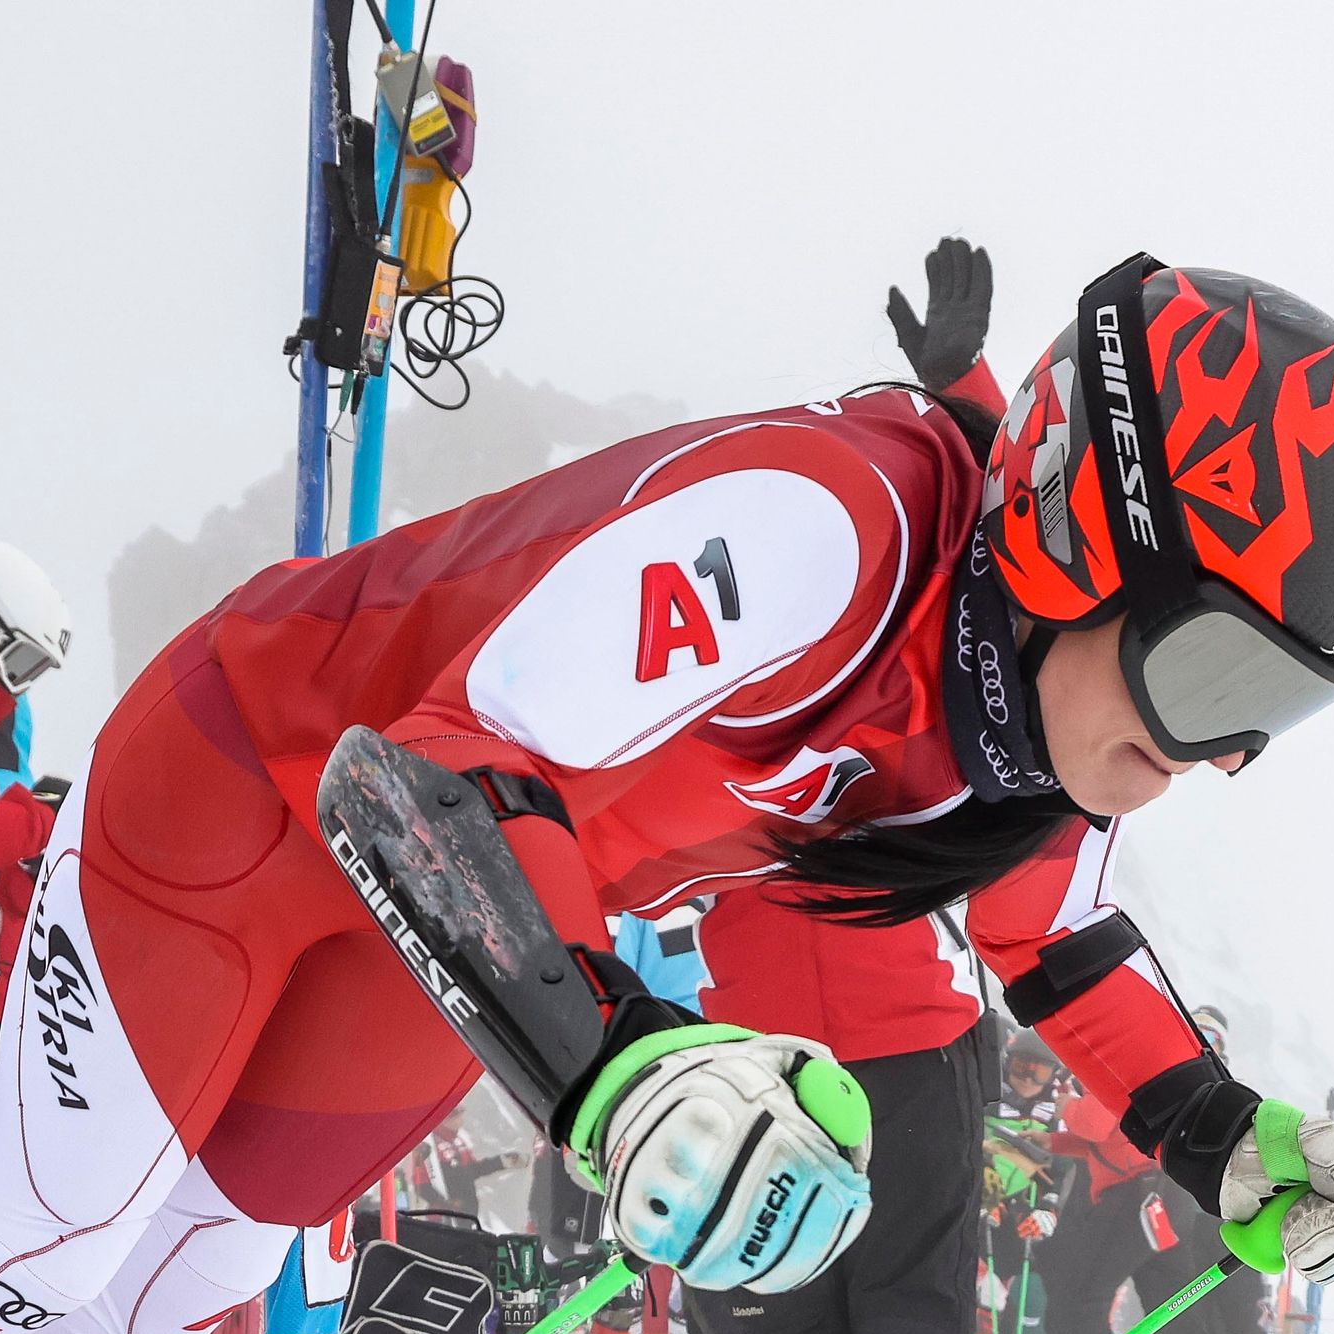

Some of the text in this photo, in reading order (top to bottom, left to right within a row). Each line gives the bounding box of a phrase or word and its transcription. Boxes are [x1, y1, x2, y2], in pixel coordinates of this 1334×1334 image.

[1096, 304, 1159, 551] DAINESE
[636, 536, 740, 683] A1
[730, 756, 872, 816] A1
[330, 829, 480, 1026] DAINESE
[739, 1171, 797, 1269] reusch
[1166, 1274, 1214, 1313] KOMPERDELL
